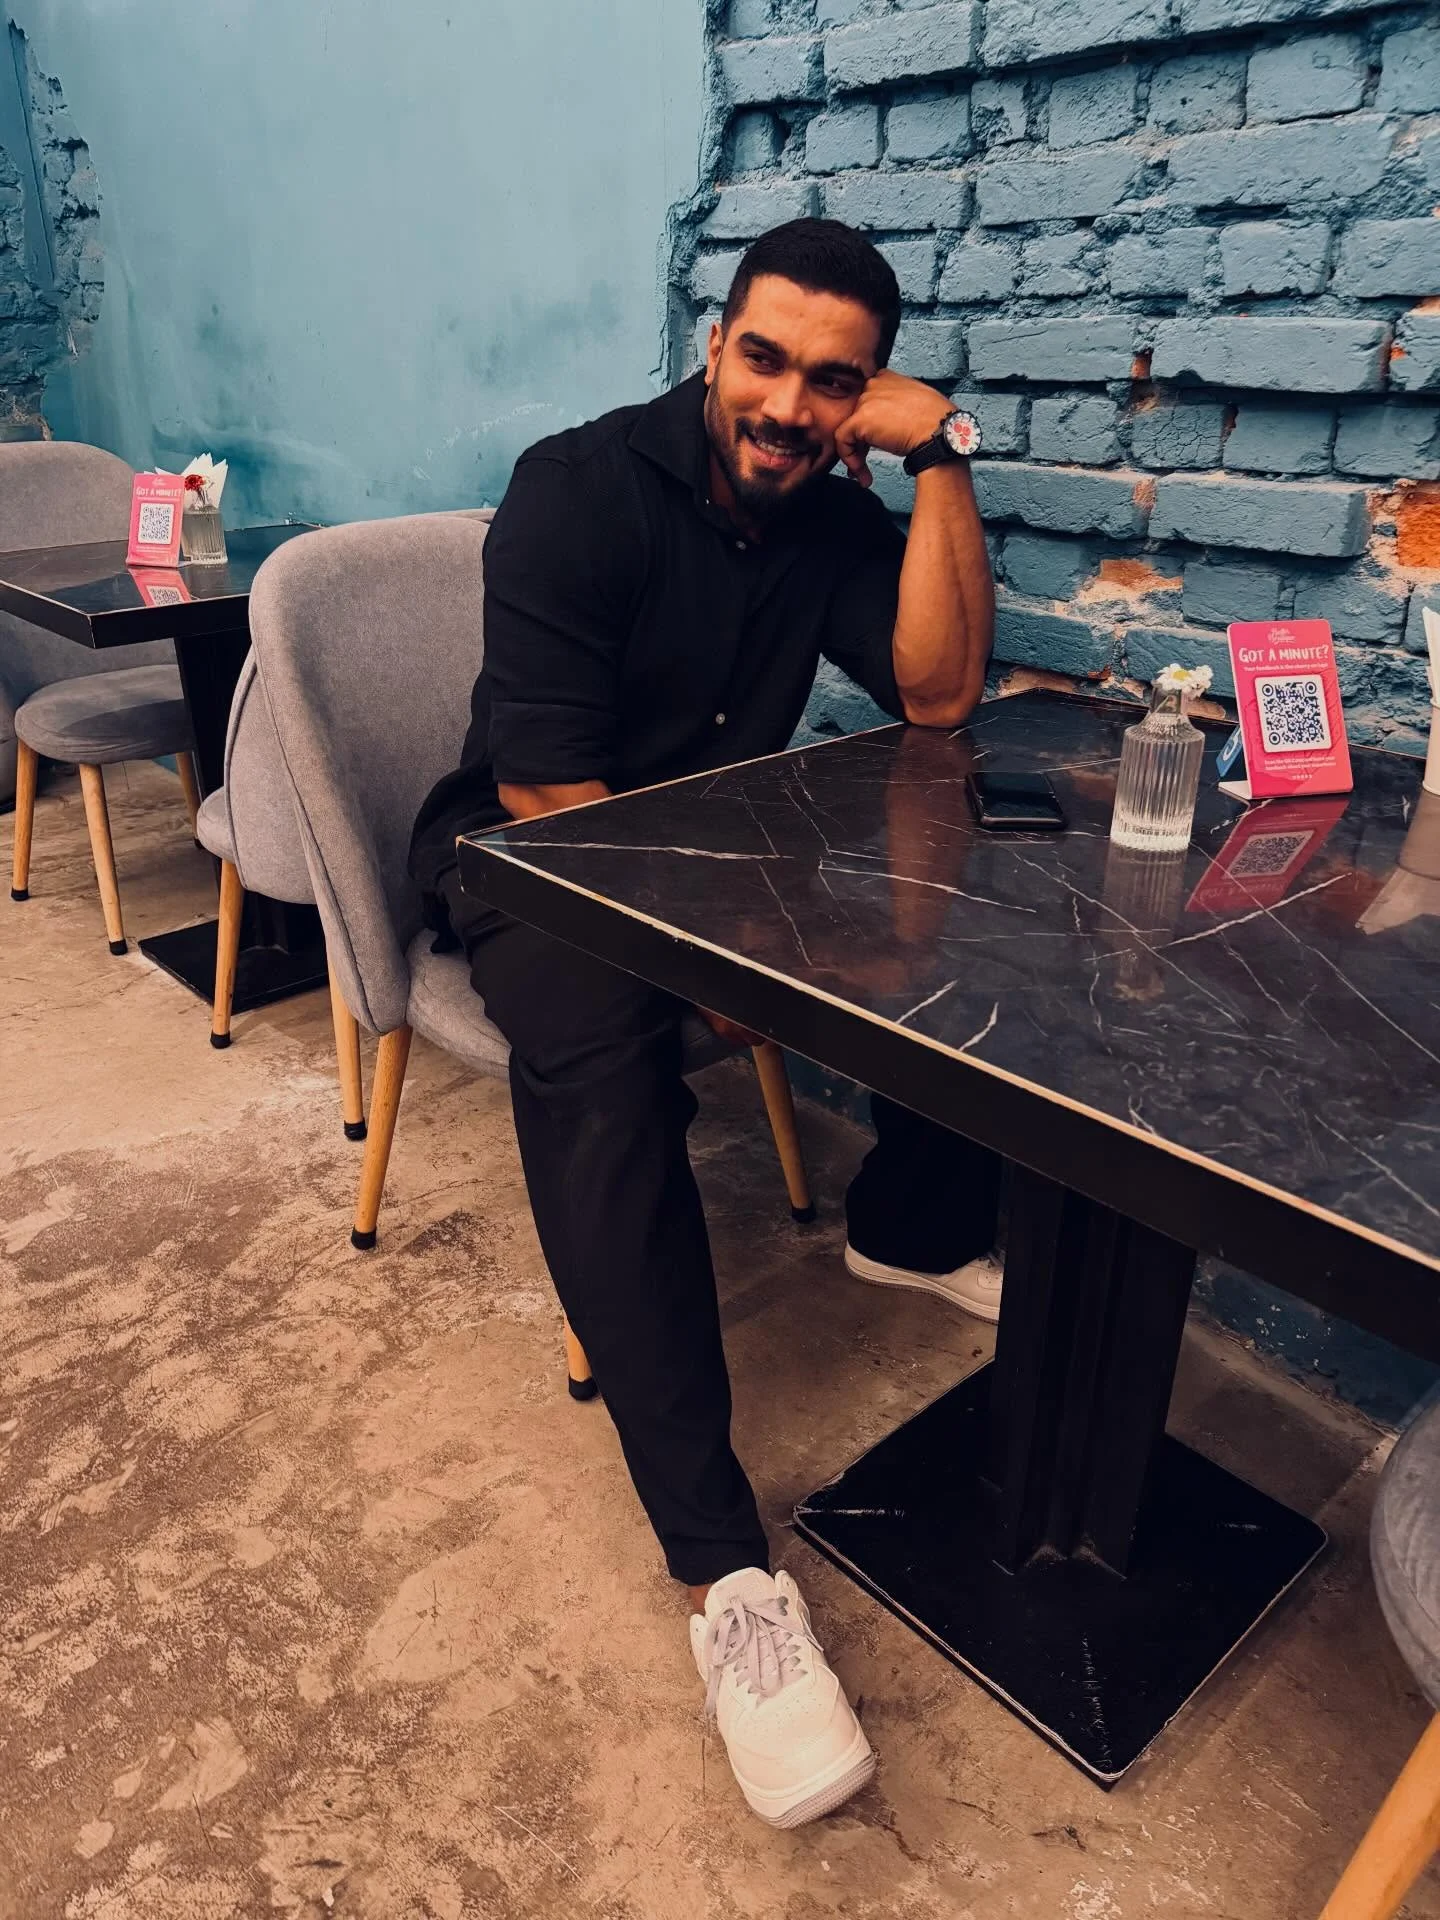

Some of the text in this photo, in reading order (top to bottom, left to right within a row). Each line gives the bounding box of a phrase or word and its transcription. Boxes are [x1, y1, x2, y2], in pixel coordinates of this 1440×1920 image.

[150, 488, 155, 497] A
[1239, 644, 1329, 663] GOT A MINUTE?
